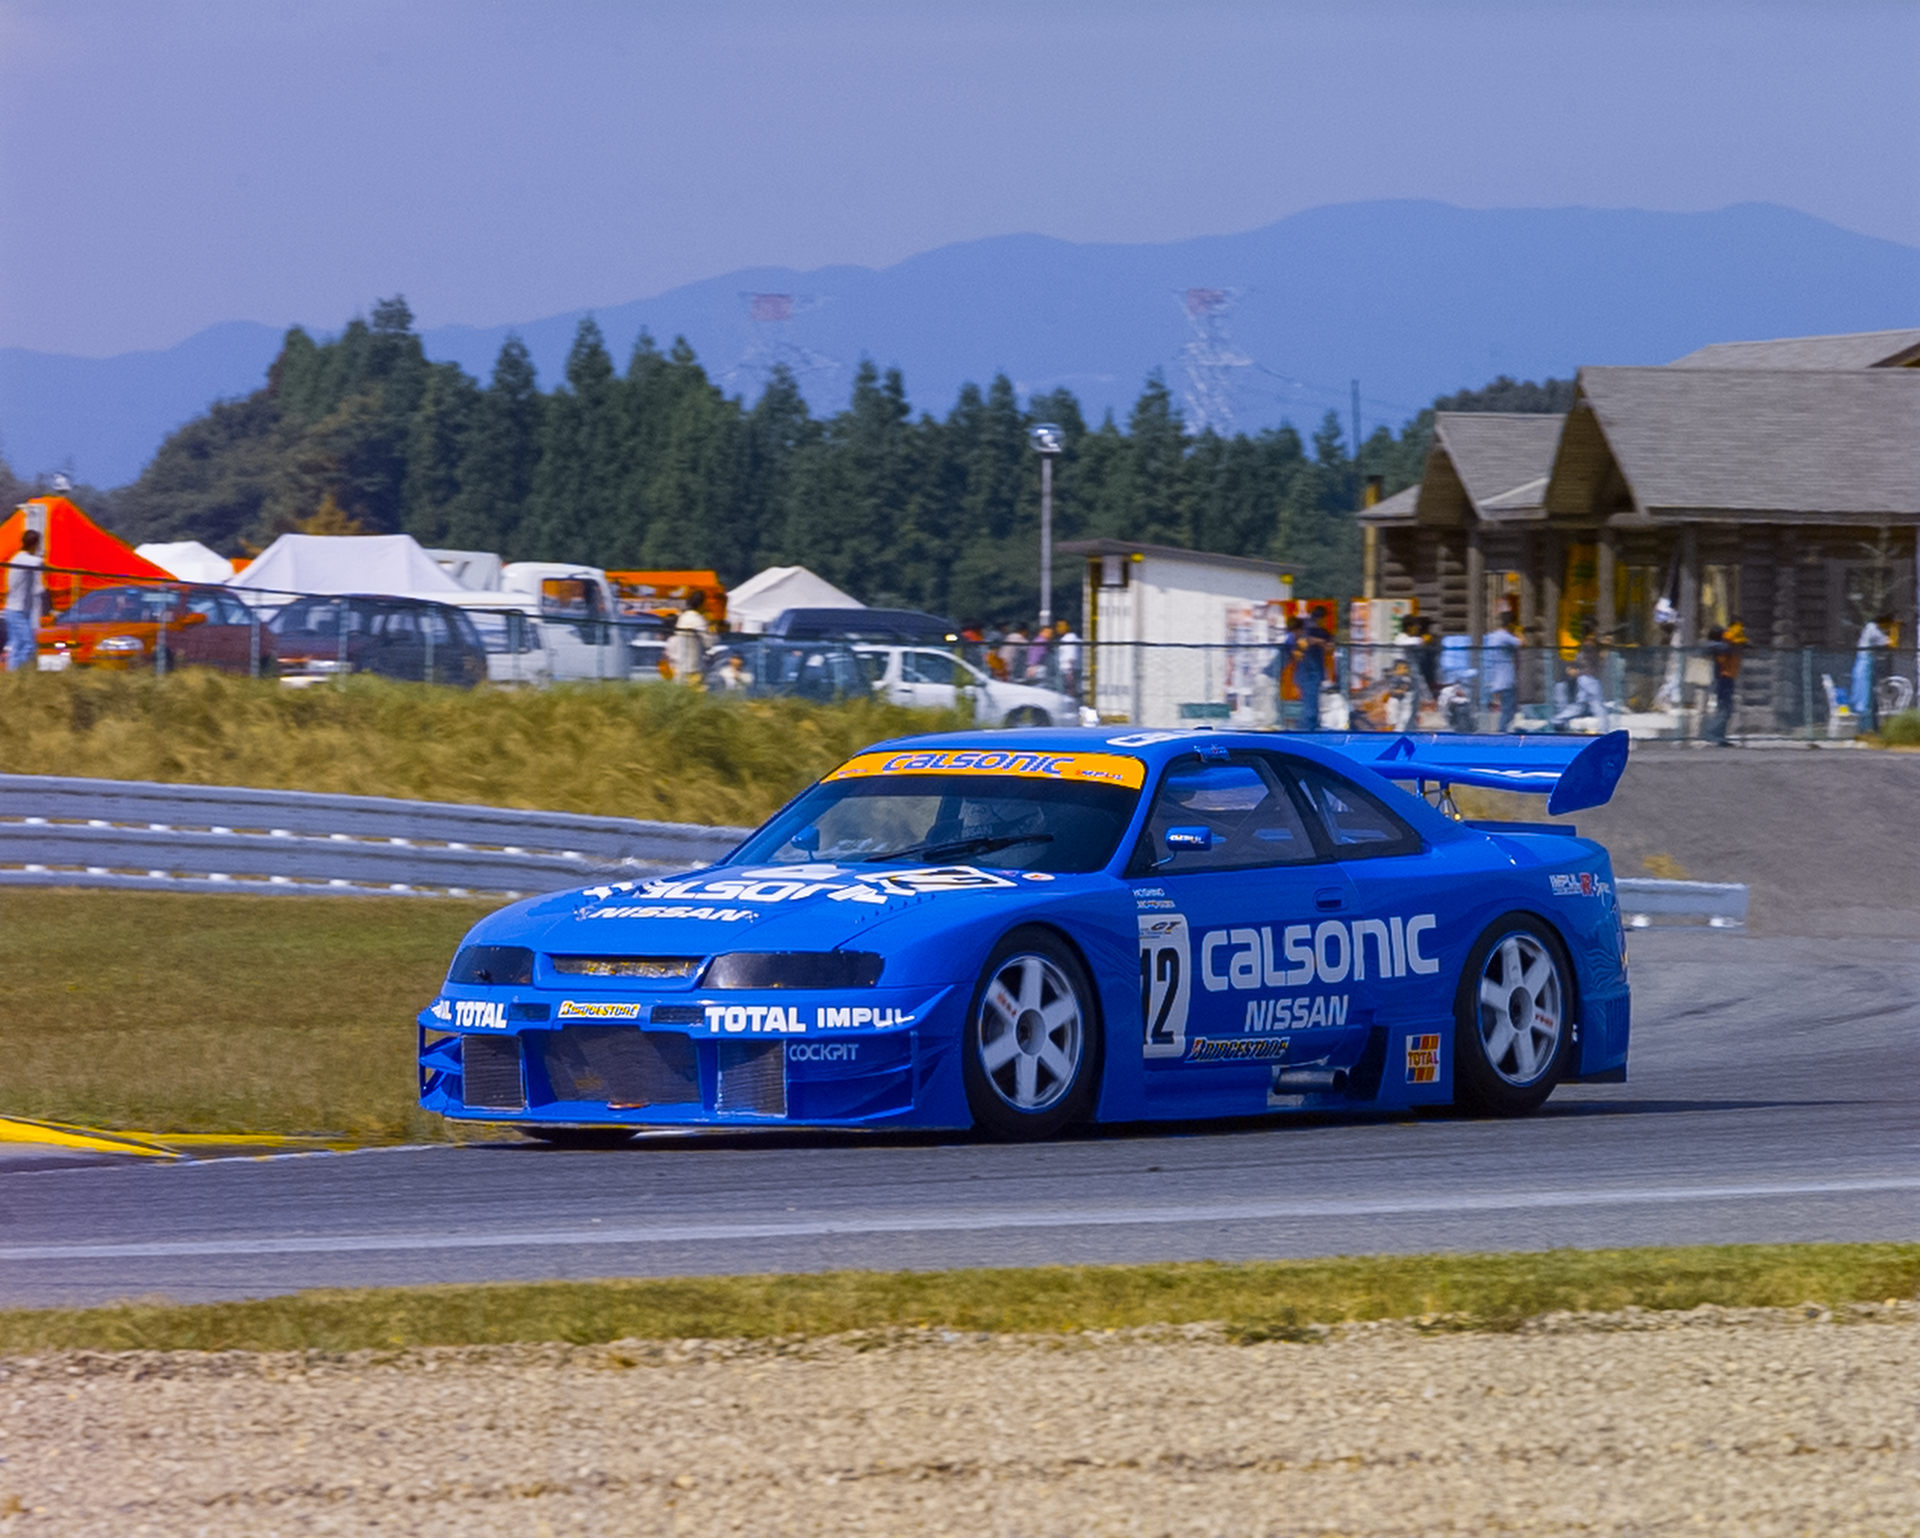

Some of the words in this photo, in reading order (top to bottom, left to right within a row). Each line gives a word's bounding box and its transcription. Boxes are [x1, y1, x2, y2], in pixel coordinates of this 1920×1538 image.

[588, 906, 754, 922] NISSAN
[456, 1001, 507, 1028] TOTAL
[705, 1006, 806, 1033] TOTAL
[817, 1007, 915, 1028] IMPUL
[1245, 995, 1349, 1032] NISSAN
[789, 1044, 859, 1061] COCKPIT
[1185, 1037, 1290, 1063] BRIDGESTONE
[1408, 1051, 1439, 1066] TOTAL
